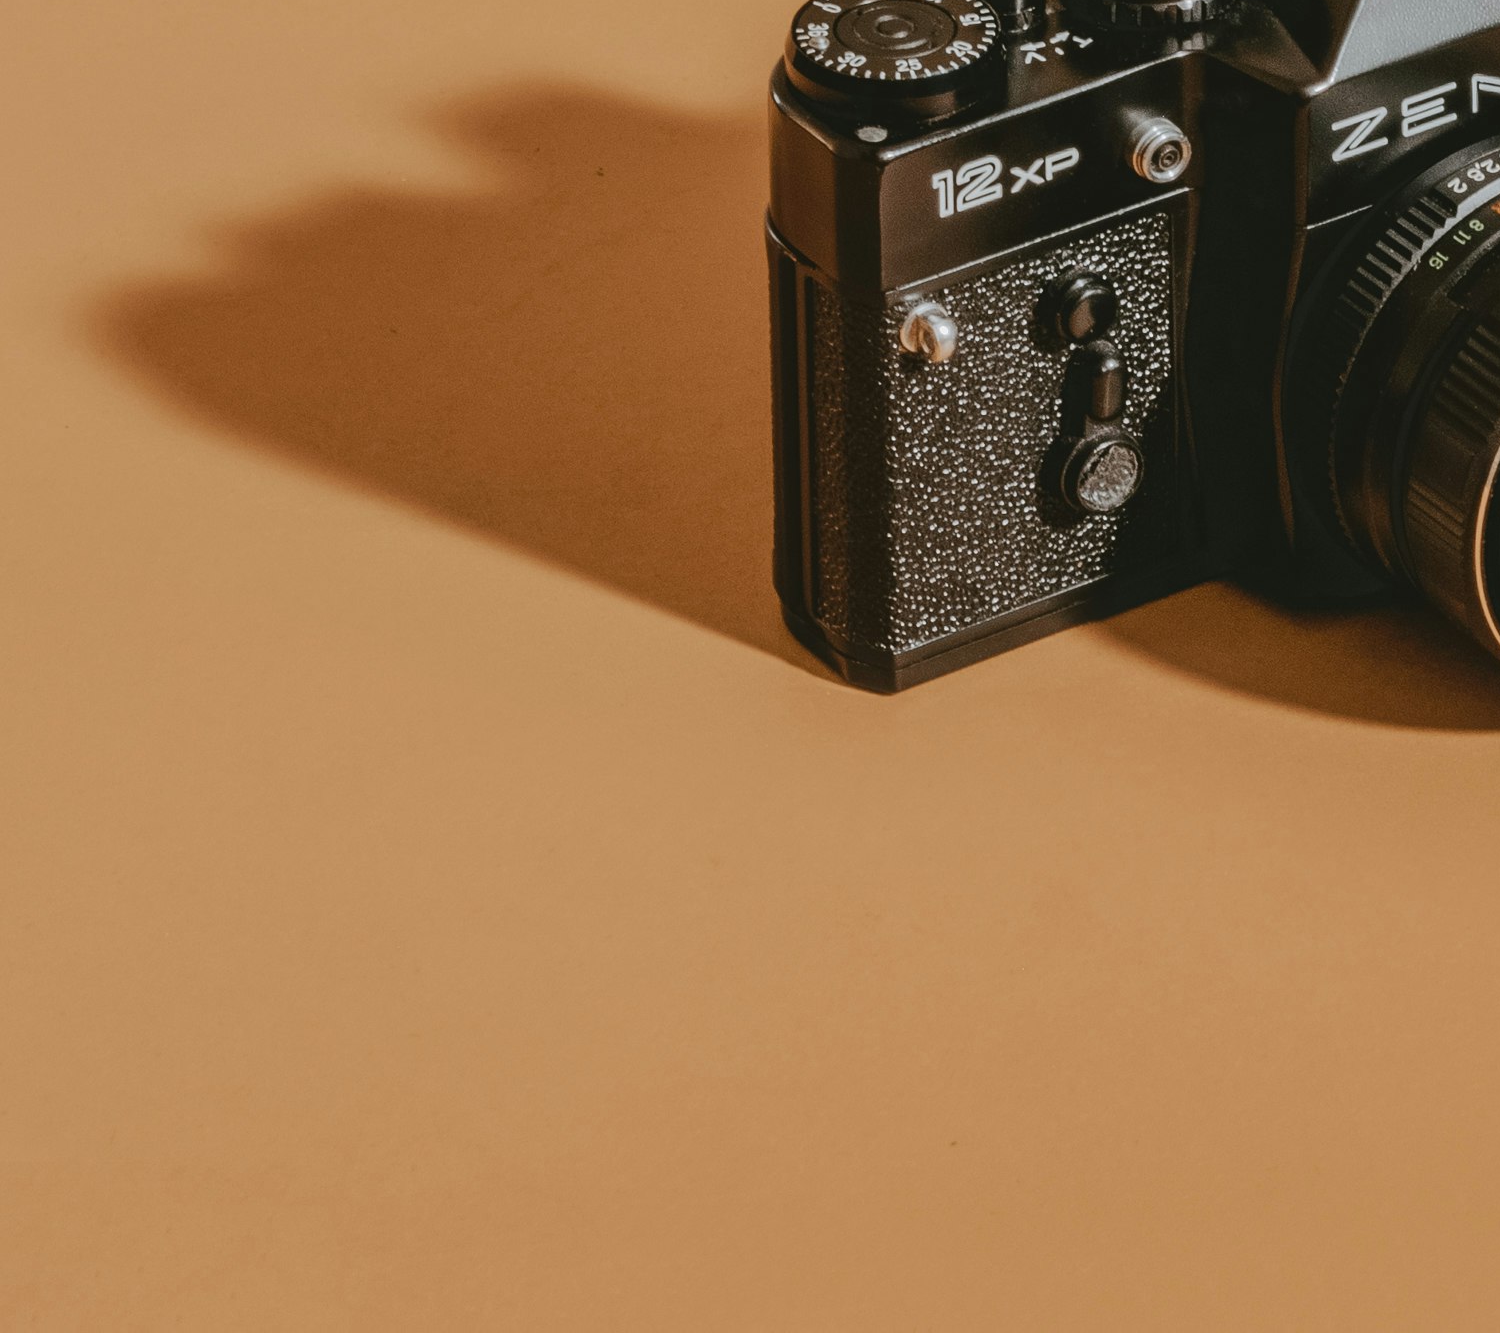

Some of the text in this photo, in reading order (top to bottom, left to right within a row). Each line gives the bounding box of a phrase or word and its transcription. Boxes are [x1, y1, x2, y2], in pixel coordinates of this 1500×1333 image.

[960, 12, 980, 27] 15
[946, 41, 972, 58] 20
[838, 50, 868, 67] 30
[896, 57, 923, 72] 25
[932, 147, 1081, 219] 12 XP
[1447, 177, 1469, 194] 2
